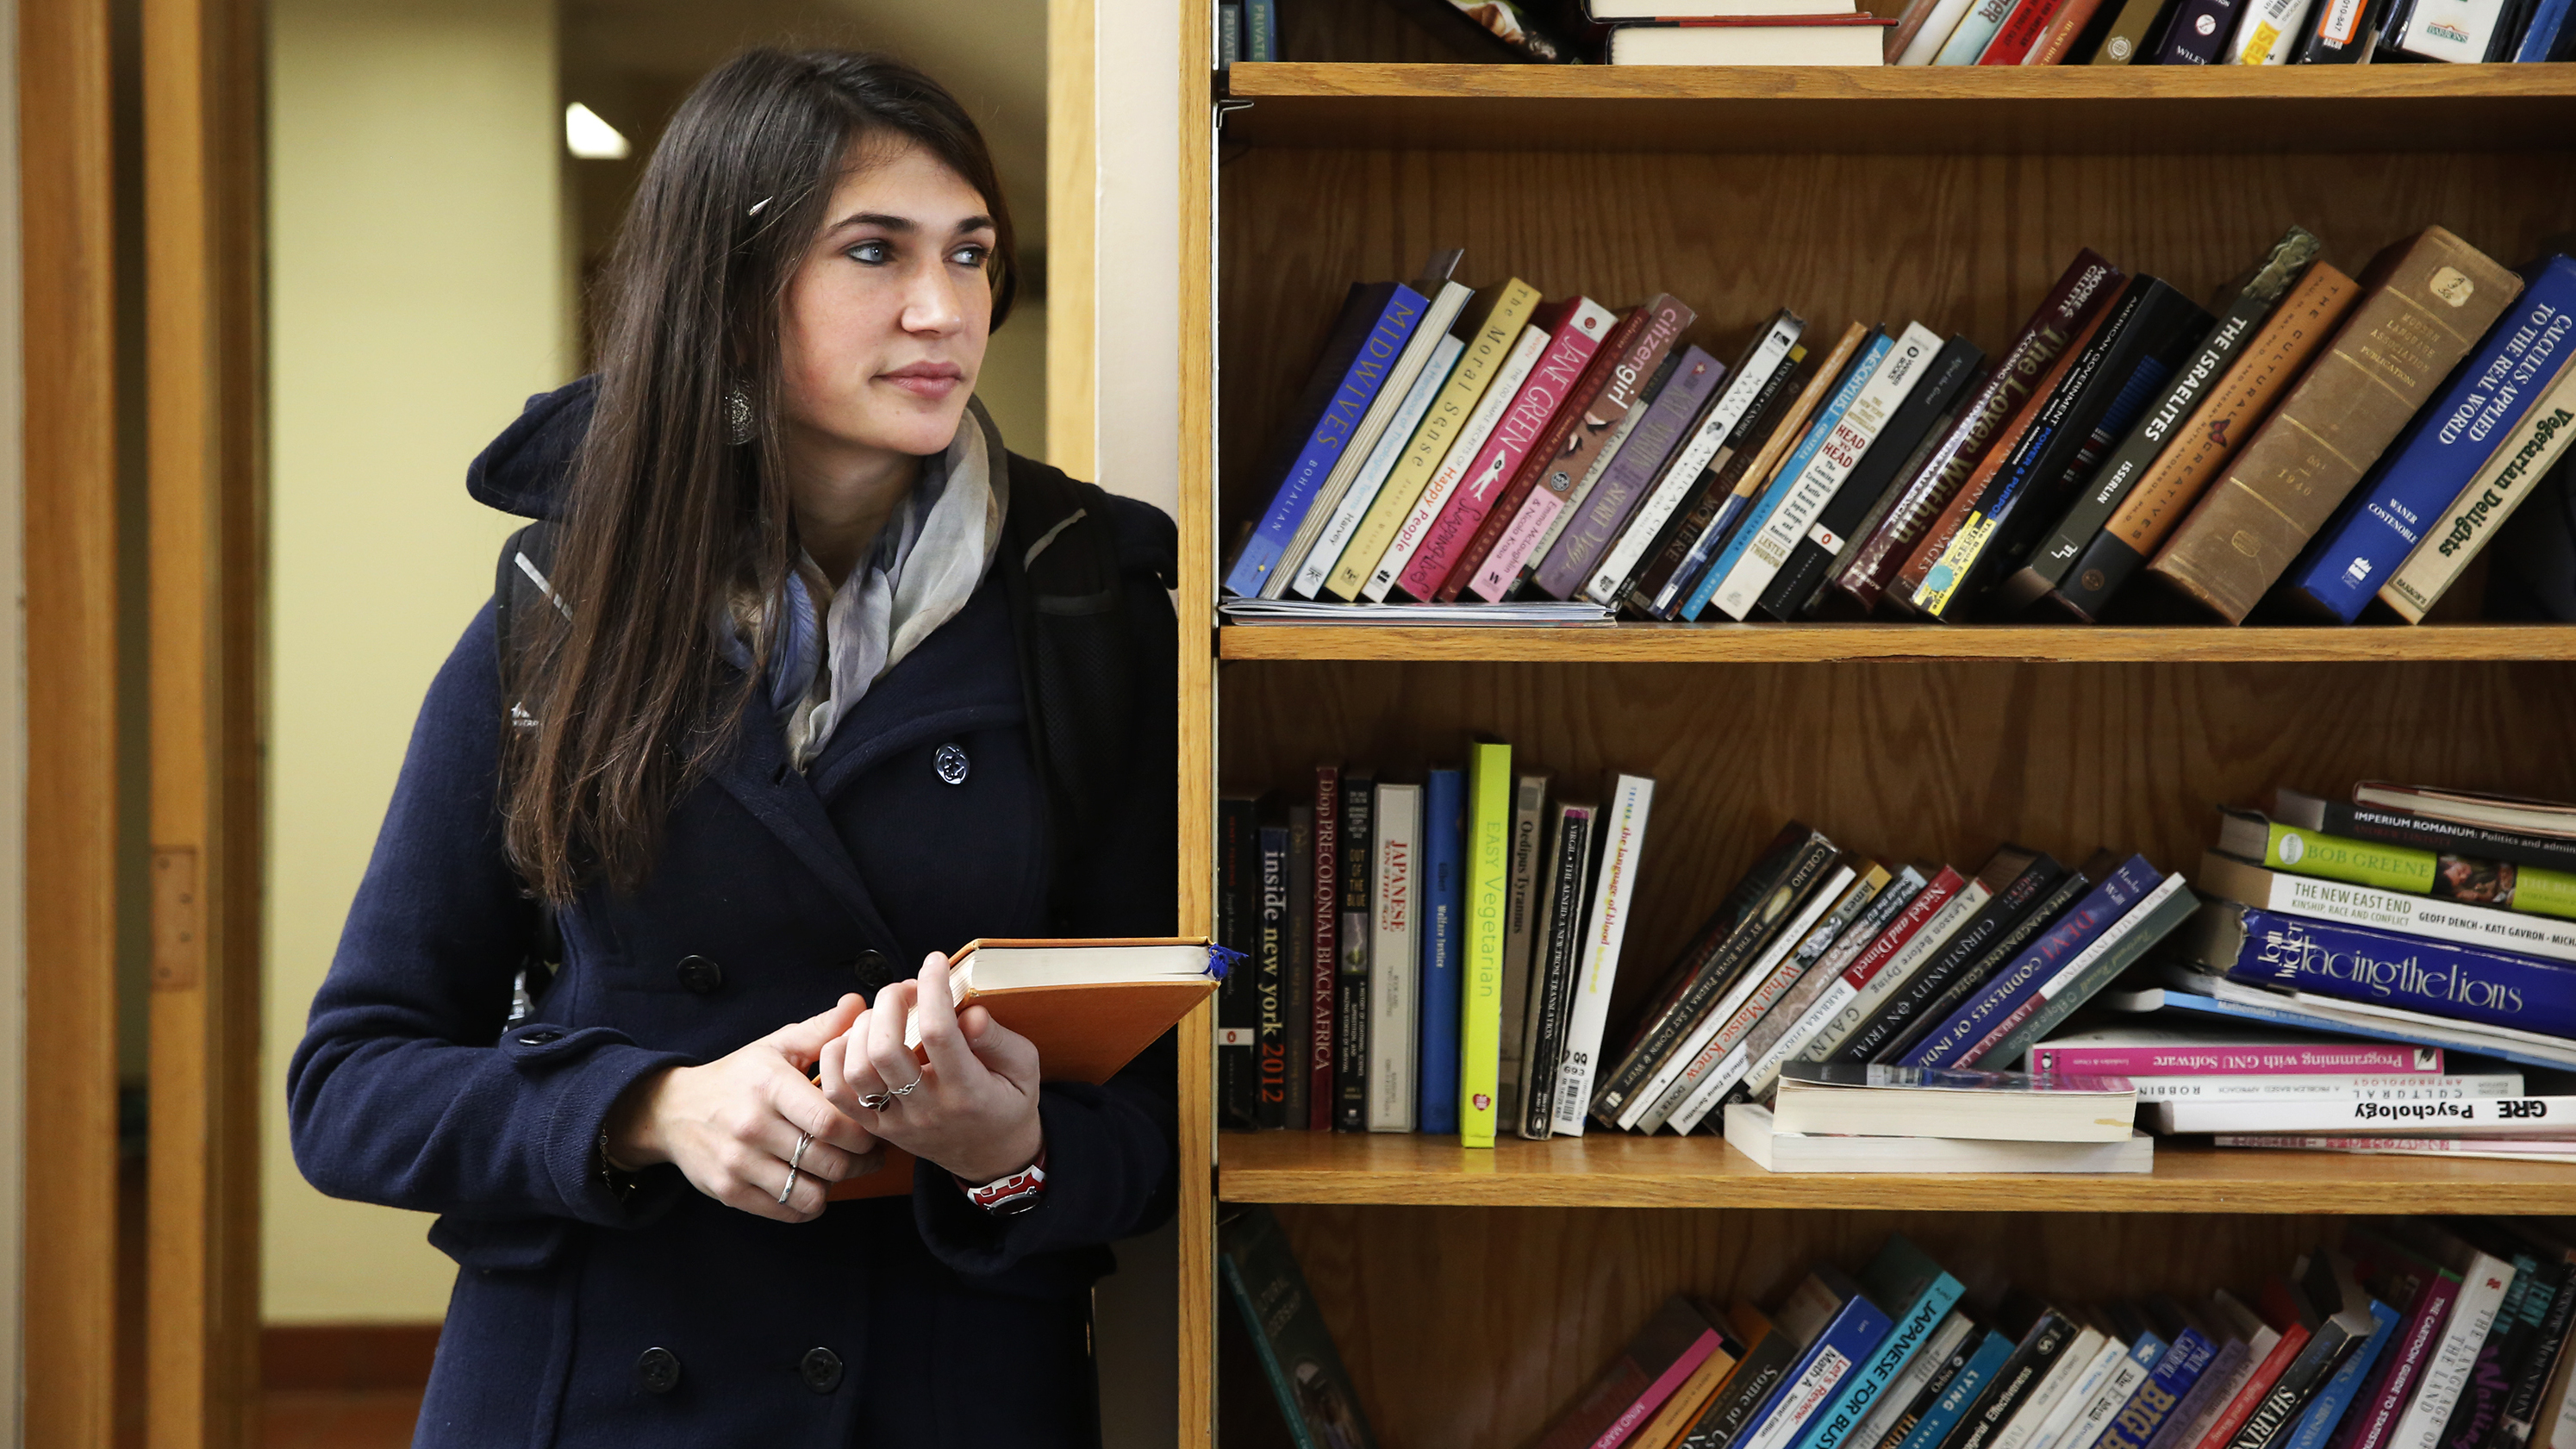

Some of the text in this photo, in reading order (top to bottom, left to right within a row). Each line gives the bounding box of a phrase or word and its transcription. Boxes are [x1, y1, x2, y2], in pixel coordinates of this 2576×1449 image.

[1254, 4, 1264, 60] PRIVATE
[2053, 18, 2074, 47] HENRY
[2177, 45, 2208, 65] WILEY
[2056, 262, 2098, 315] GILLETTE
[2072, 265, 2108, 310] MOORE
[2016, 321, 2070, 382] The
[2098, 295, 2139, 352] AMERICAN
[2224, 284, 2339, 422] THE CULTURAL
[2368, 327, 2432, 373] ASSOCIATION
[2385, 319, 2436, 358] LANGUAGE
[2401, 312, 2441, 342] MODERN
[1409, 286, 1528, 470] The Moral Sense
[1831, 347, 1884, 412] AESCHYLUS
[1996, 328, 2037, 380] ACCESSING
[2359, 344, 2417, 387] PUBLICATIONS
[2436, 298, 2556, 446] TO THE REAL WORLD
[2466, 311, 2574, 445] CALCULUS APPLIED
[1270, 300, 1414, 532] MIDWIVES BOHJALIAN
[1498, 334, 1591, 455] JANE GREEN
[1959, 373, 2031, 459] Lover
[2048, 351, 2102, 426] GOVERNMENT
[2095, 312, 2248, 504] THE ISRAELITES ISSERLIN
[1327, 369, 1438, 546] Handbook Theological Harvey
[1822, 441, 1854, 469] HEAD
[1835, 423, 1866, 451] HEAD
[1837, 440, 1851, 453] TO
[2022, 426, 2052, 466] POWER
[1391, 398, 1502, 554] SIMPLE Happy People
[1588, 481, 1630, 528] SECRET
[1663, 445, 1712, 514] AMERICAN
[1813, 465, 1836, 484] Coming
[1889, 450, 1975, 553] Within
[2130, 440, 2212, 540] CREATIVES
[2432, 399, 2576, 561] Vegetarian Delights
[1495, 505, 1535, 560] Nicola Kraus
[1502, 499, 1557, 576] Emma McLaughlin
[2365, 501, 2420, 544] COSTENOBLE
[2387, 497, 2419, 524] WANER
[1749, 542, 1783, 570] THUROW
[1757, 534, 1787, 558] LESTER
[1916, 532, 1949, 572] SAGES
[1567, 824, 1578, 854] VIRGIL
[2354, 810, 2540, 848] IMPERIUM ROMANUM: Politics and
[1388, 840, 1408, 932] JAPANESE
[1509, 820, 1534, 934] Oedipus Tyrannus
[1600, 827, 1631, 945] the language of blood
[2306, 844, 2430, 878] BOB GREENE
[1313, 779, 1334, 1069] Diop PRECOLONIAL BLACK AFRICA
[1474, 821, 1502, 996] EASY Vegetarian
[1689, 846, 1826, 1007] COELHO RIVER PIEDRA
[2291, 897, 2409, 927] KINSHIP, RACE AND CONFLICT
[2294, 882, 2411, 915] THE NEW EAST END
[2418, 911, 2543, 941] GEOFF DENCH KATE GAVRON
[1436, 904, 1446, 968] Welfare Justice
[1868, 901, 1967, 996] Lesson Before Dying
[1257, 850, 1286, 1102] inside new york 2012
[1683, 879, 1876, 1085] James What Maisie Knew
[1752, 881, 1947, 1081] Nickel and Dimed BARBARA EHRENREICH
[1848, 914, 1997, 1062] CHRISTIANITY TRIAL
[1950, 909, 2096, 1040] DEVI GODDESSES OF
[2217, 1001, 2276, 1018] Mathematics
[1564, 1066, 1584, 1076] 693
[2153, 1052, 2402, 1070] Programming with GNU Software
[2352, 1077, 2461, 1087] ANTHROPOLOGY
[2352, 1088, 2461, 1099] CULTURAL
[2355, 1100, 2547, 1121] GRE Psychology
[1871, 1300, 1941, 1380] JAPANESE
[2382, 1295, 2446, 1410] THE CARTOON GUIDE TO
[2429, 1306, 2494, 1427] THE LANGUAGE
[1756, 1348, 1838, 1439] Math Second Edition
[1787, 1358, 1849, 1425] Let's Review:
[1843, 1378, 1878, 1415] FOR
[1942, 1368, 1980, 1412] LYING
[1983, 1364, 2035, 1423] Effectiveness
[2417, 1333, 2465, 1415] THE LAND
[1619, 1401, 1645, 1427] MIND
[1702, 1363, 1780, 1449] Some of Us
[2114, 1375, 2178, 1444] BIG
